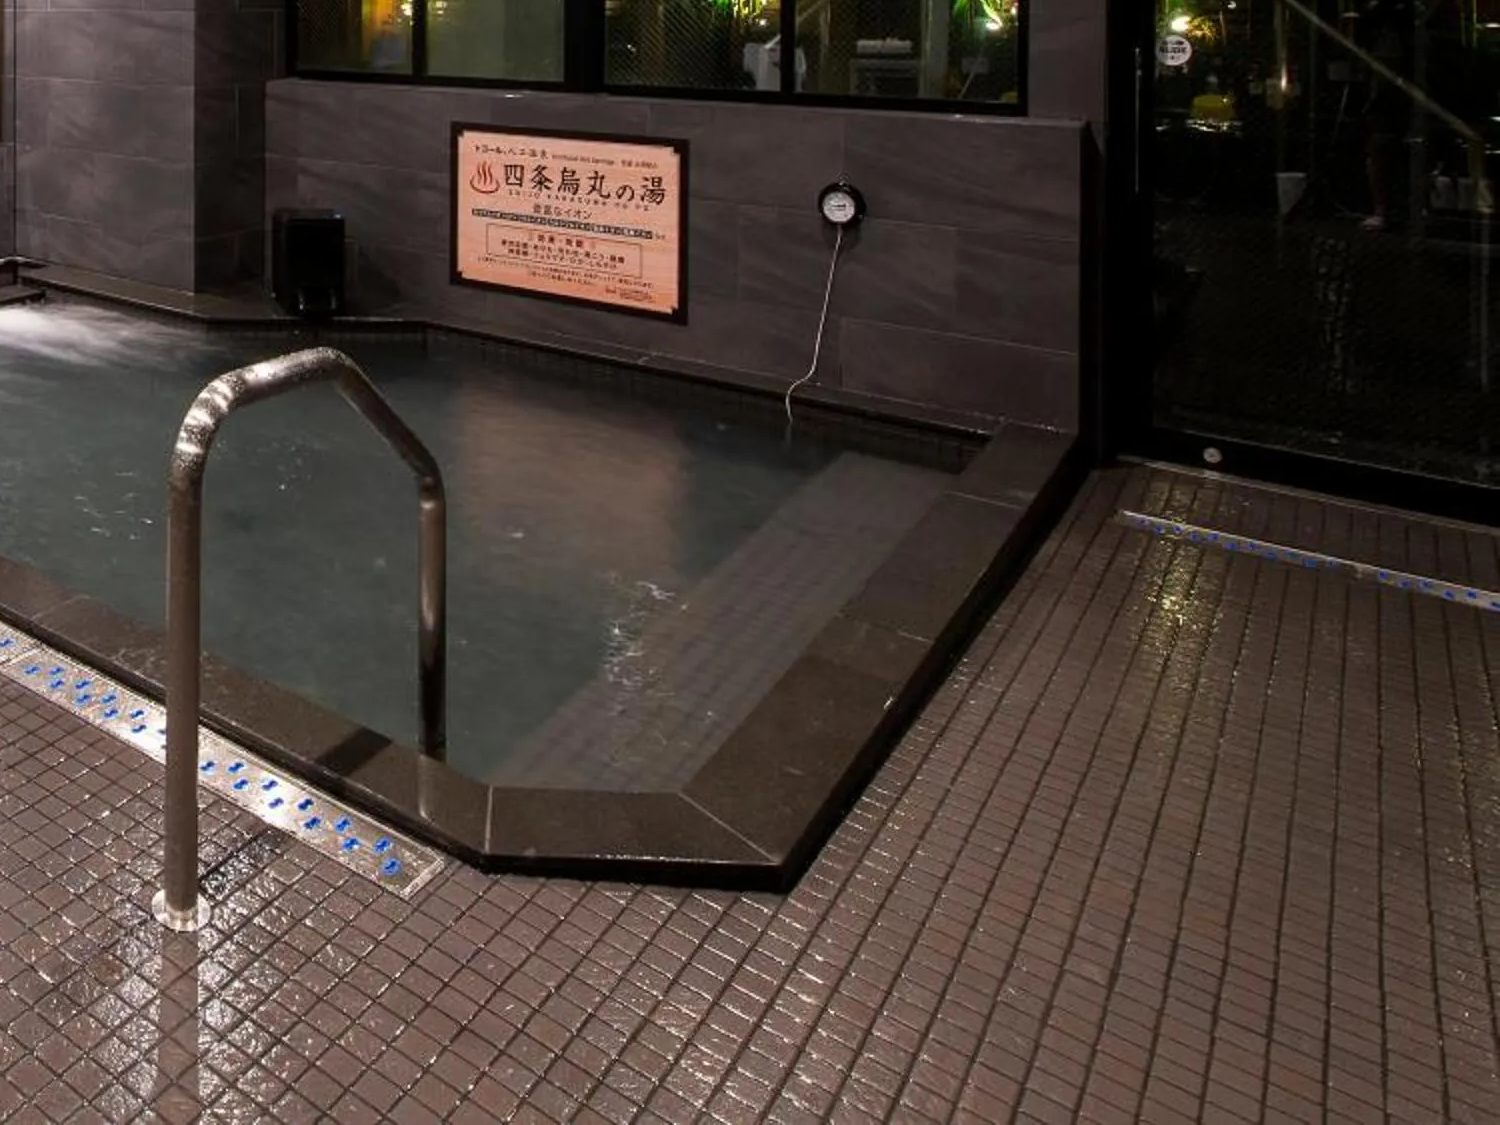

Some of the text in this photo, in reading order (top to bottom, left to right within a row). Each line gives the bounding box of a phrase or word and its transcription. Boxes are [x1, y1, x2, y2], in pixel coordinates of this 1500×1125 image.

[503, 164, 666, 206] 四条烏丸の湯
